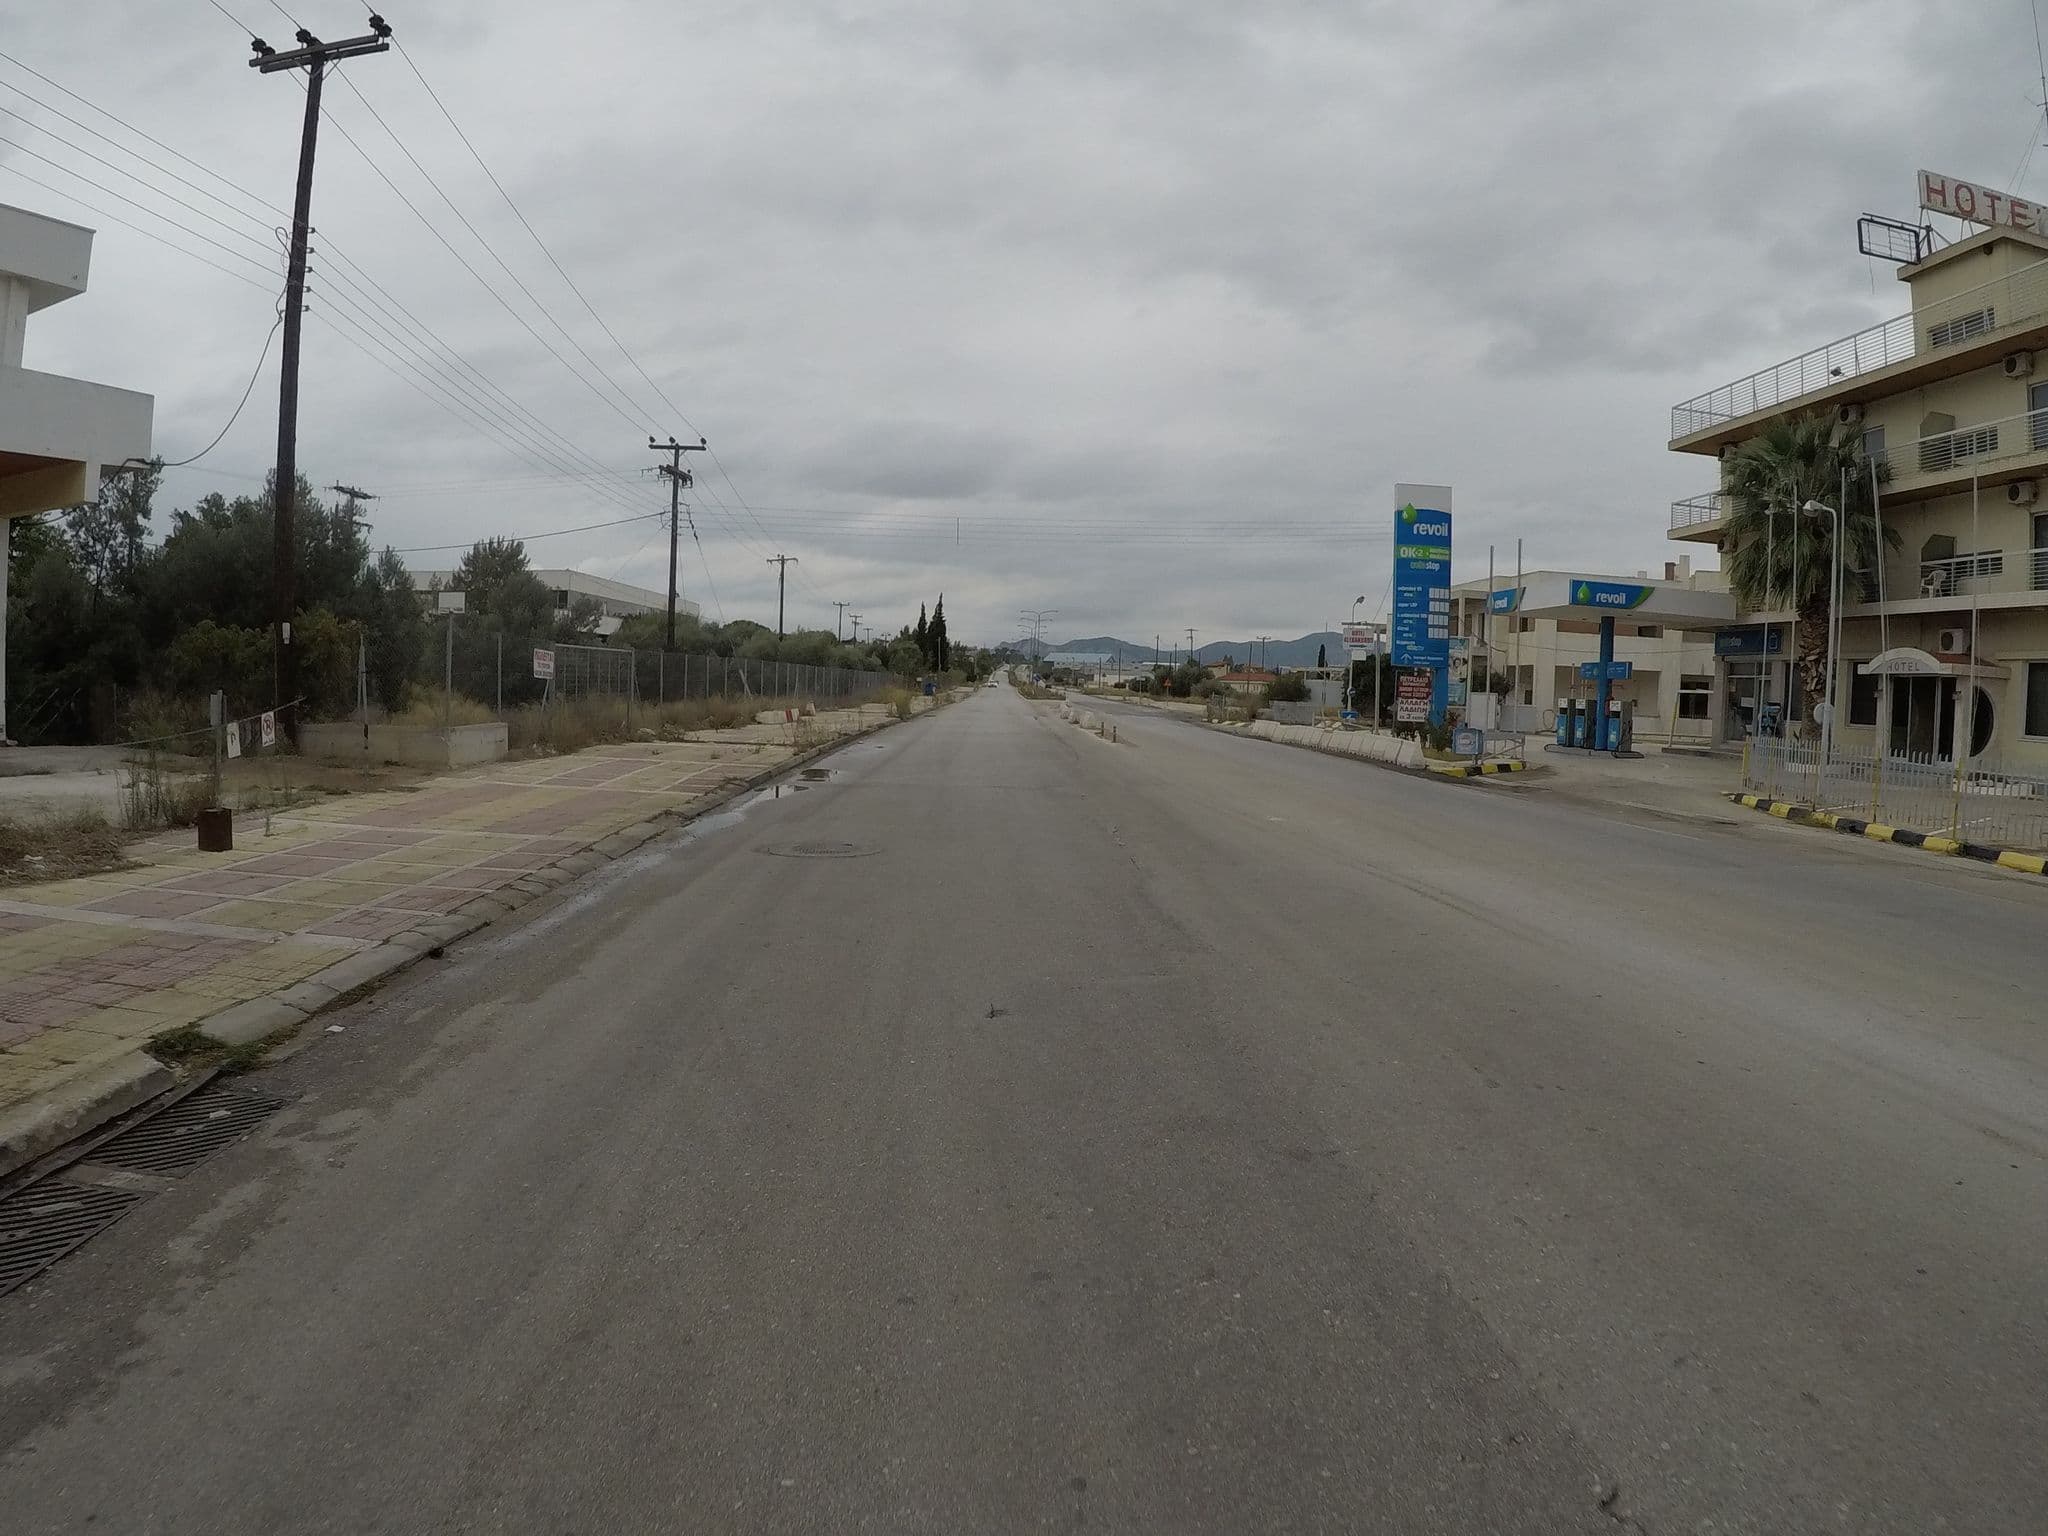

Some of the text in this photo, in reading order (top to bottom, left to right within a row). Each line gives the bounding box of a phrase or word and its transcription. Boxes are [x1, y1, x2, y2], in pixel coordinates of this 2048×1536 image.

[1925, 174, 2041, 231] HOTE
[1413, 522, 1448, 537] revoil
[1596, 592, 1626, 605] revoil
[1887, 662, 1920, 672] HOTEL
